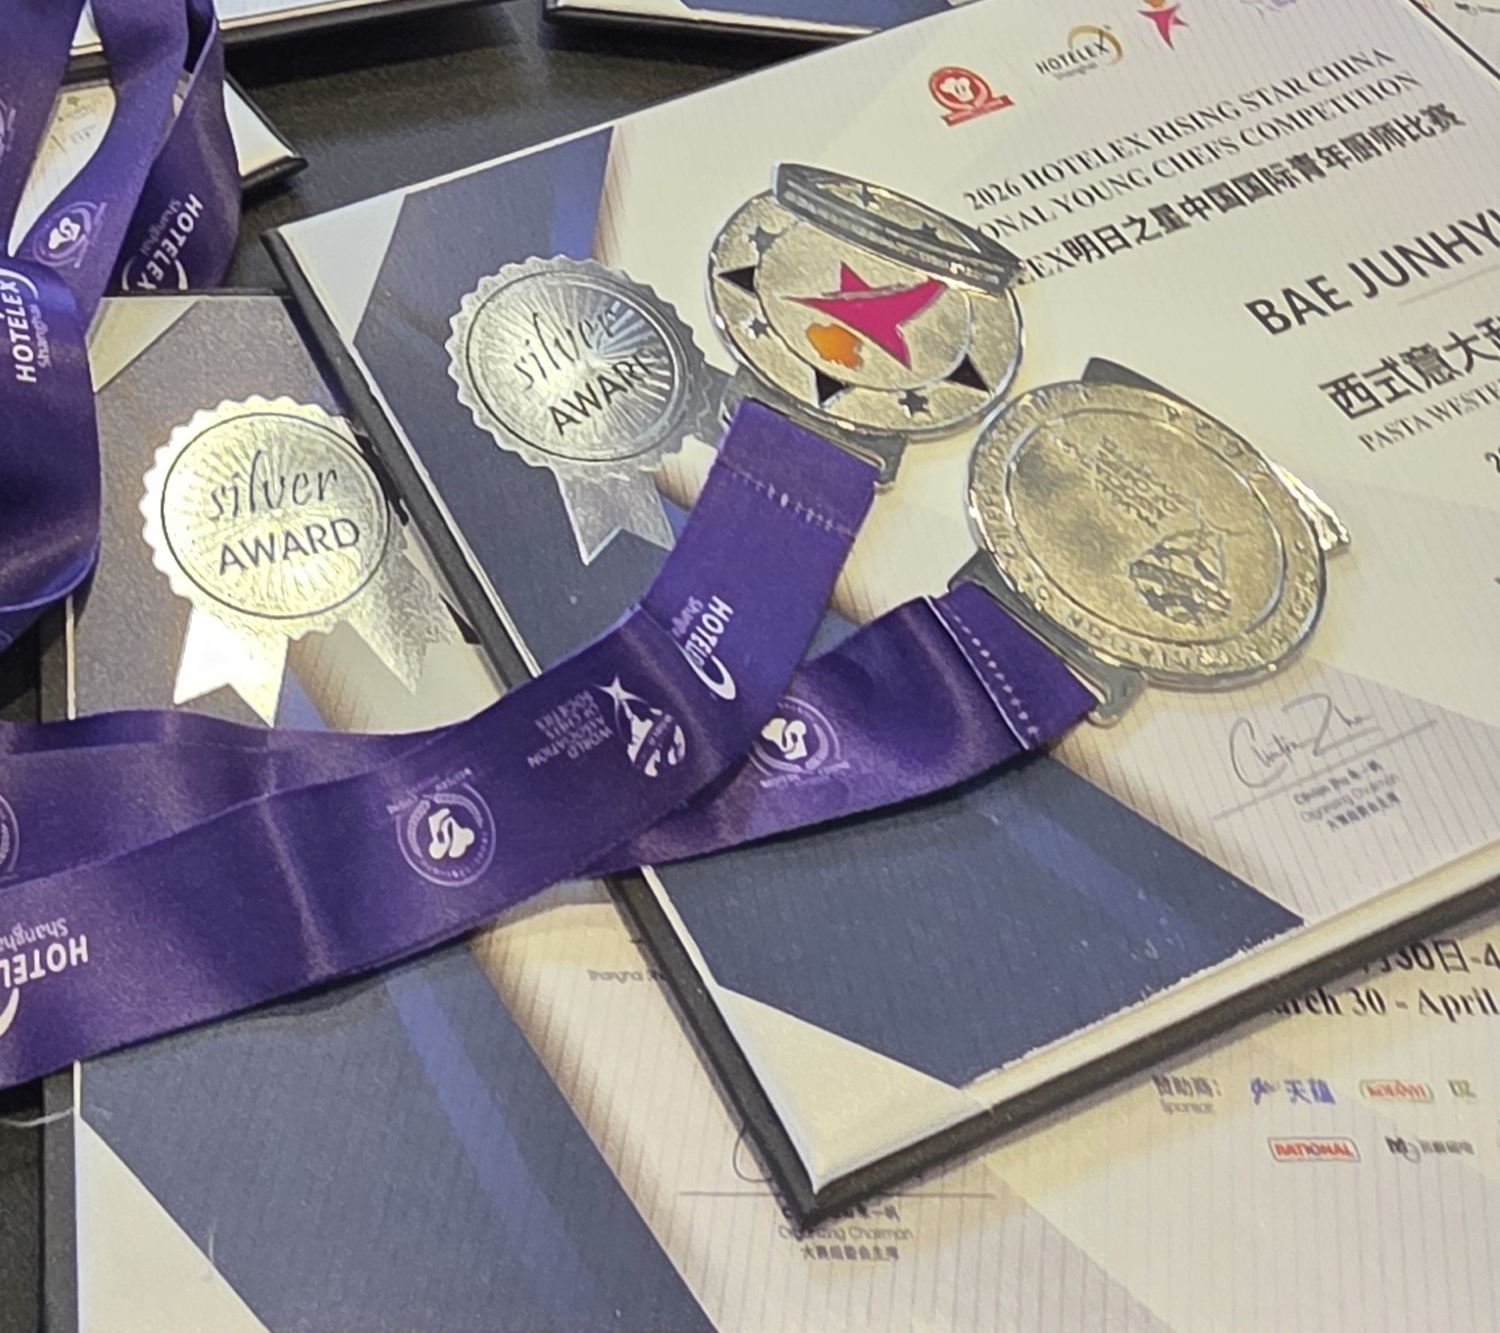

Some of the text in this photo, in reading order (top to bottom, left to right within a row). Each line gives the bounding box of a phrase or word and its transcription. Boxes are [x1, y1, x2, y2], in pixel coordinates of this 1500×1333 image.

[1034, 30, 1112, 75] HOTELEX
[963, 46, 1397, 211] 2026 HOTELEX RISING STAR CHINA
[1049, 70, 1424, 215] YOUNG CHEFS COMPETITION
[137, 193, 204, 292] HOTELEX
[1244, 273, 1354, 337] BAE
[1357, 413, 1434, 454] PASTA
[206, 448, 338, 522] silver
[219, 517, 361, 576] AWARD
[1350, 988, 1387, 1016] 30
[1417, 986, 1500, 1024] April
[1272, 1142, 1355, 1159] RATIONAL
